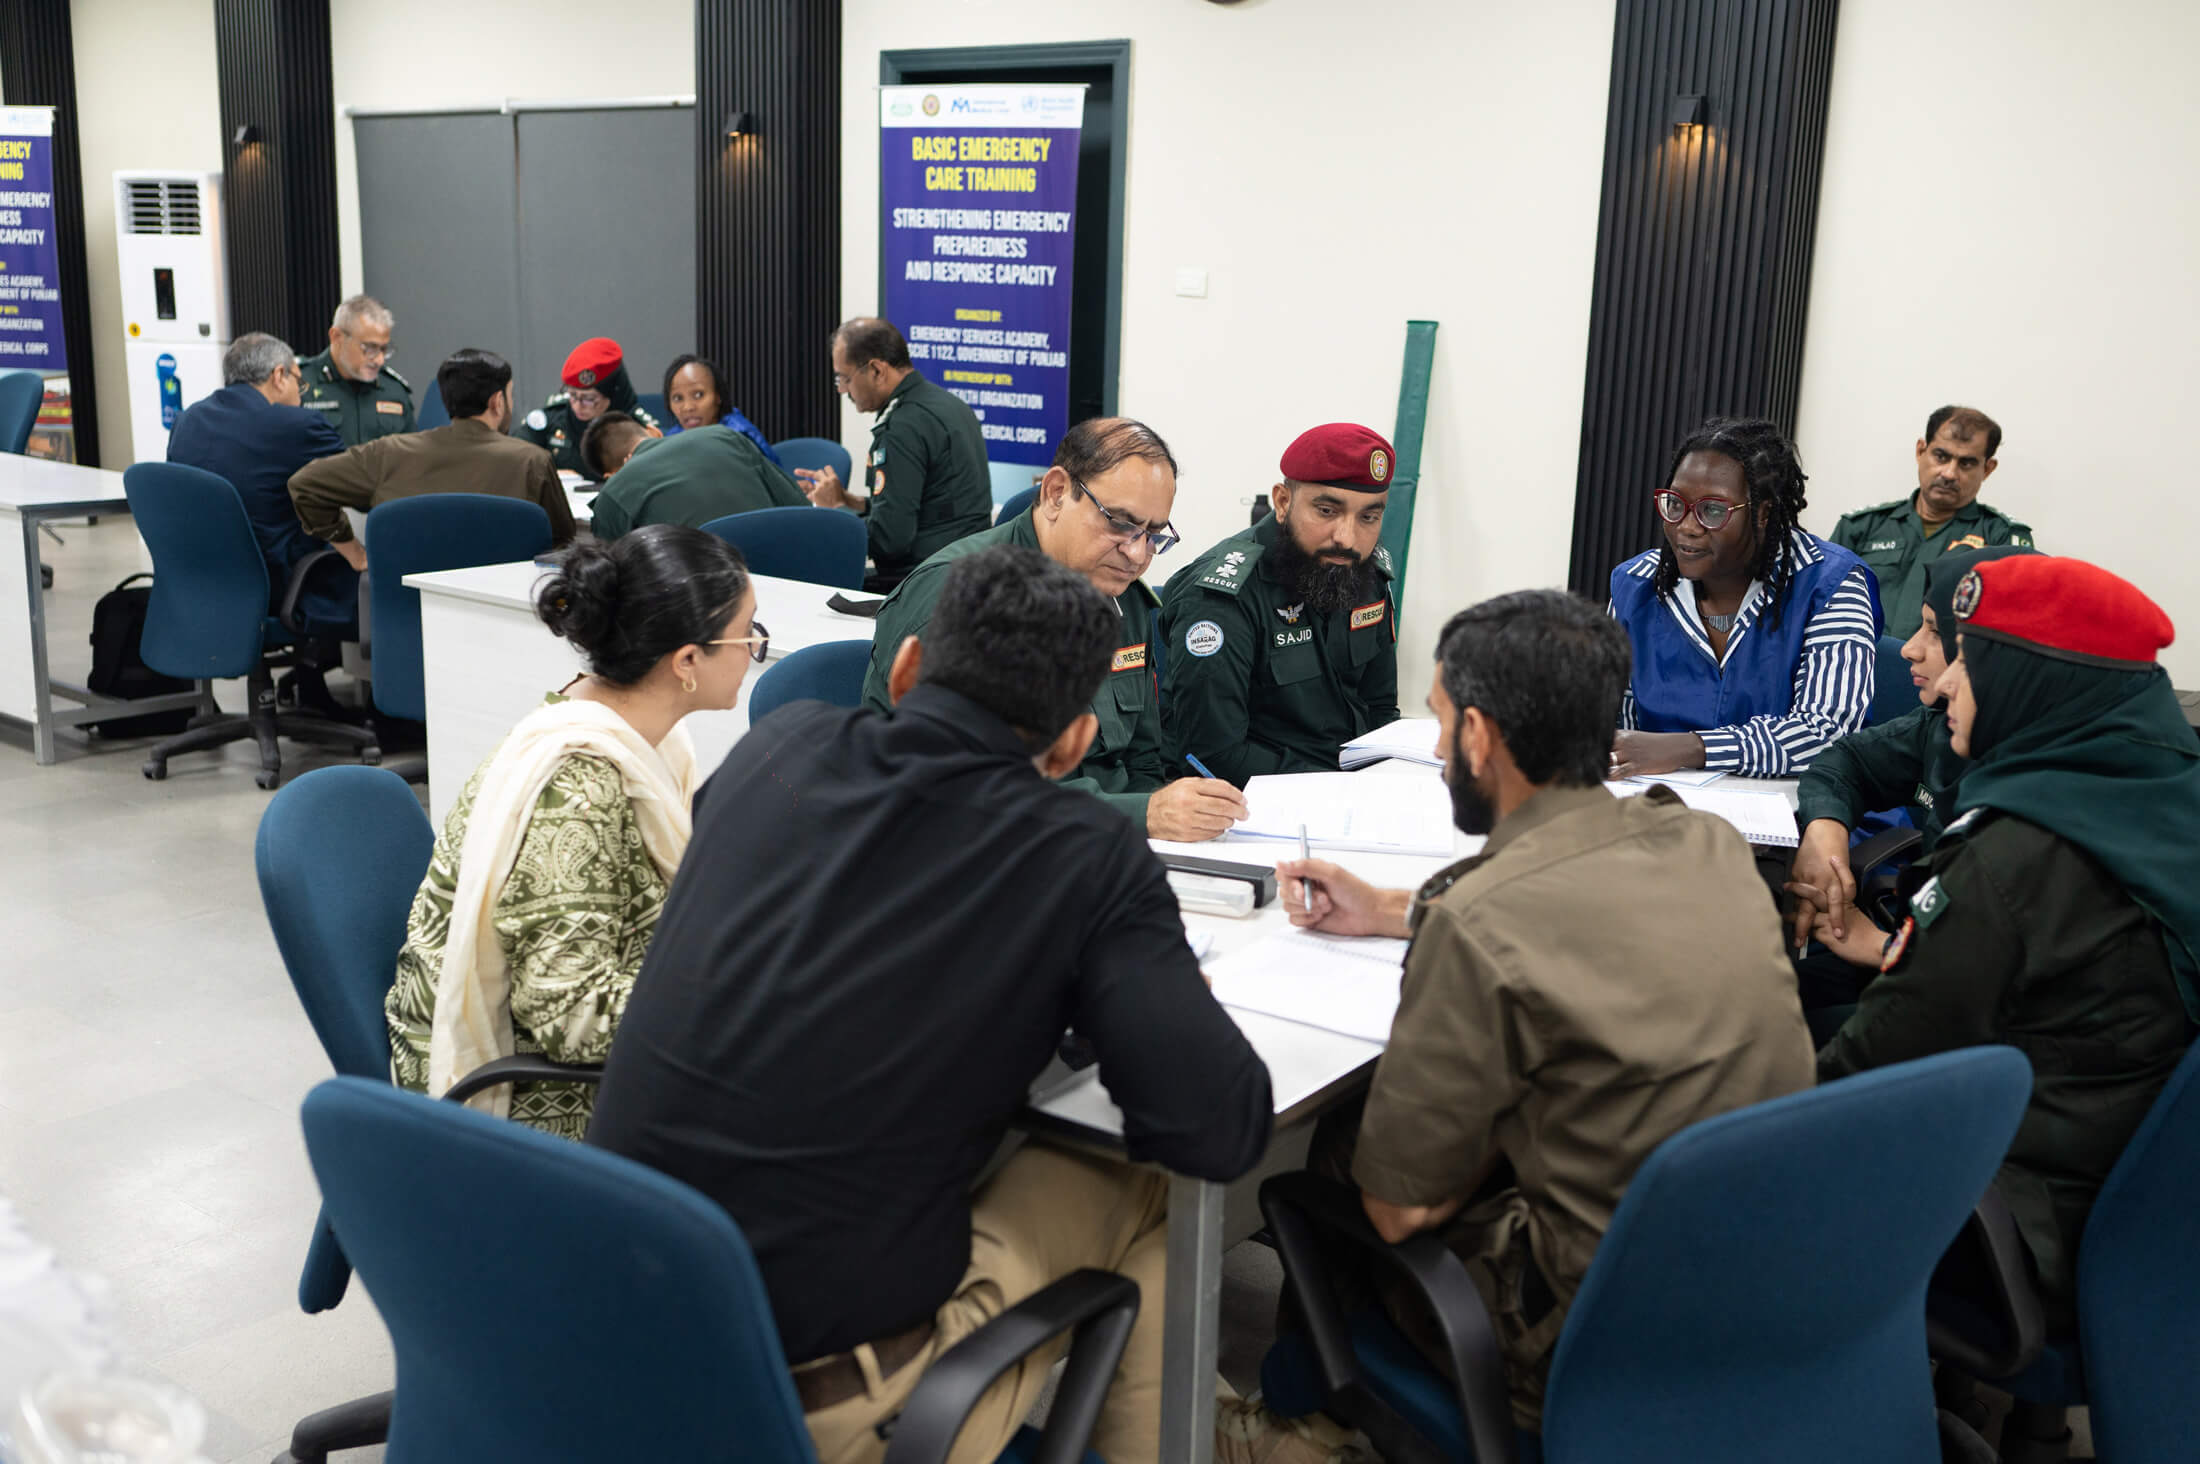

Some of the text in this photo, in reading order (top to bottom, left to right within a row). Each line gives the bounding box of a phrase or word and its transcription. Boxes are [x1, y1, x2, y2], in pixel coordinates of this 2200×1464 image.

[912, 136, 1051, 162] BASIC EMERGENCY
[925, 166, 1036, 192] CARE TRAINING
[893, 208, 1071, 232] STRENGTHENING EMERGENCY
[933, 235, 1028, 258] PREPAREDNESS
[905, 260, 1057, 286] AND RESPONSE CAPACITY
[909, 325, 961, 343] EMERGENCY
[962, 328, 1004, 346] SERVICES
[906, 342, 930, 360] SCUE
[957, 346, 1015, 364] GOVERNMENT
[1015, 349, 1029, 366] OF
[1029, 350, 1067, 368] PUNJAB
[980, 390, 1043, 410] ORGANIZATION
[1016, 426, 1047, 444] CORPS
[1203, 576, 1238, 590] RESCUE
[1276, 628, 1312, 646] SAJID
[1122, 650, 1145, 663] RESC
